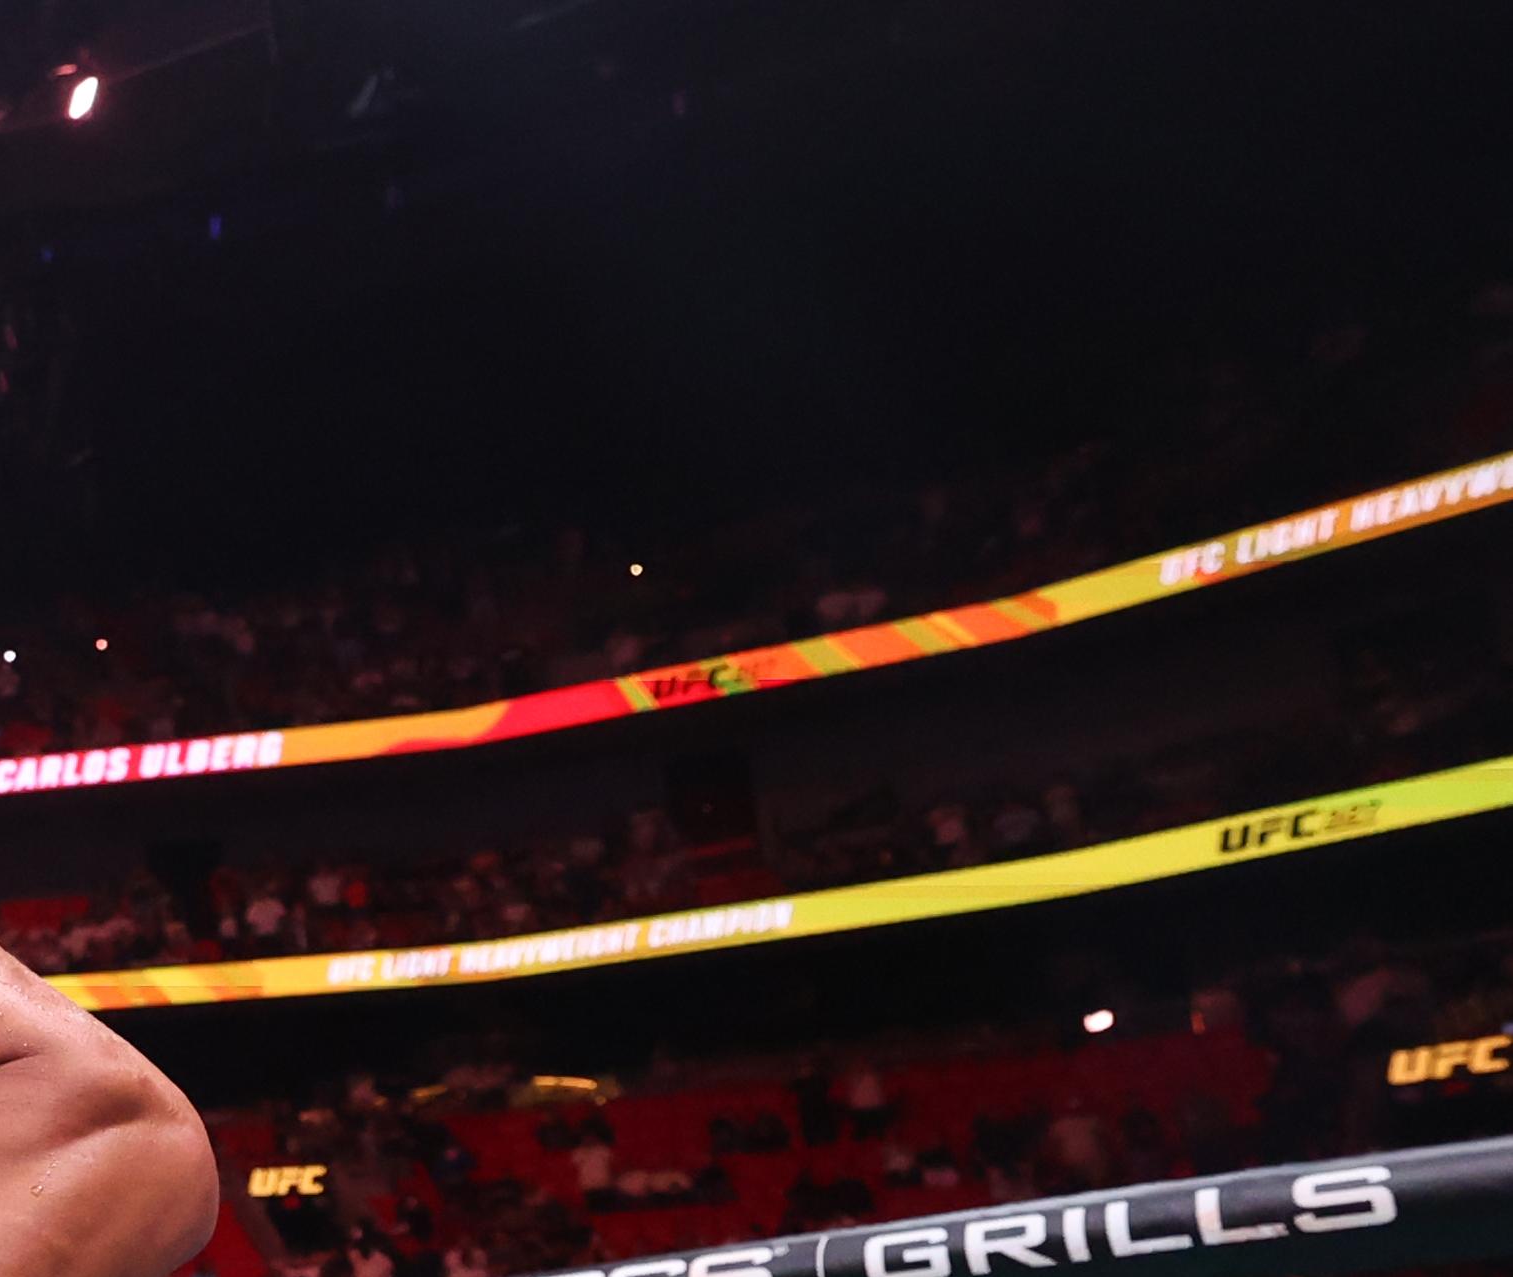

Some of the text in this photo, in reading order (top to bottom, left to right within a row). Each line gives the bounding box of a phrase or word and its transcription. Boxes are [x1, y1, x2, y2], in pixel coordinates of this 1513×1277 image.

[1235, 509, 1339, 564] LIGHT
[138, 731, 284, 779] ULBERG
[1220, 809, 1319, 852] UFC
[647, 902, 794, 949] CHAMPION
[1387, 1034, 1513, 1086] UFC
[248, 1165, 327, 1197] UFC
